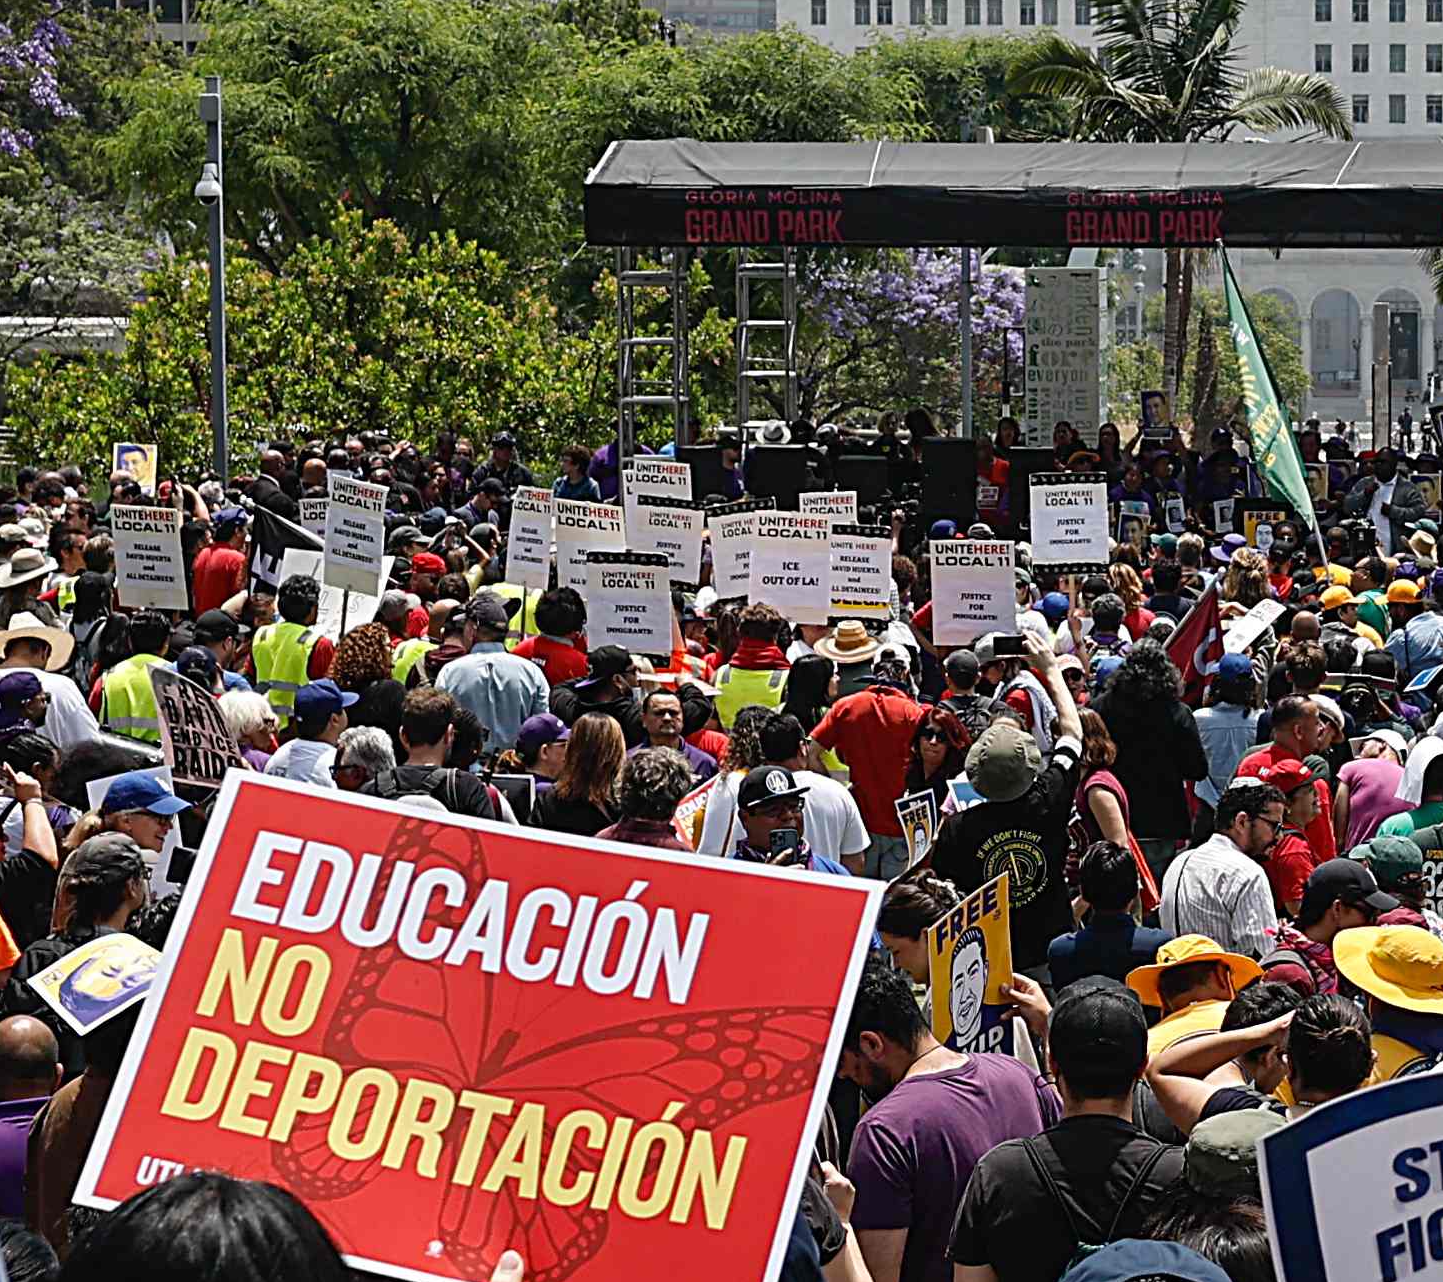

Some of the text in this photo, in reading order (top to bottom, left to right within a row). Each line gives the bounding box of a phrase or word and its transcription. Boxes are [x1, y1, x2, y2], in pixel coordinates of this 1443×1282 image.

[685, 190, 842, 204] GLORIA MOLINA
[1068, 191, 1224, 206] GLORIA MOLINA
[684, 209, 844, 243] GRAND PARK
[1067, 210, 1224, 243] GRAND PARK
[636, 474, 686, 485] LOCAL 11
[332, 493, 382, 512] LOCAL 11
[514, 502, 540, 512] LOCAL
[1045, 497, 1093, 506] LOCAL 11
[557, 503, 620, 520] UNITEHERE!
[803, 506, 853, 514] LOCAL 11
[114, 520, 175, 534] LOCAL 11
[557, 515, 621, 532] LOCAL 11
[649, 518, 691, 530] LOCAL 11
[759, 516, 828, 528] UNITEHERE!
[1057, 518, 1085, 526] JUSTICE
[722, 527, 752, 538] LOCAL
[758, 528, 827, 540] LOCAL 11
[935, 544, 1009, 555] UNITEHERE!
[782, 562, 800, 571] ICE
[936, 556, 1010, 567] LOCAL 11
[630, 572, 654, 580] HERE!
[762, 576, 819, 586] OUT OF LA!
[602, 579, 655, 589] LOCAL 11
[960, 593, 991, 601] JUSTICE
[614, 605, 647, 613] JUSTICE
[969, 603, 984, 611] FOR
[623, 616, 640, 624] FOR
[172, 726, 237, 755] END ICE
[1019, 829, 1042, 844] FIGHT
[230, 828, 711, 1006] EDUCACIÓN
[934, 883, 998, 958] FREE
[194, 927, 333, 1039] NO
[159, 1029, 750, 1232] DEPORTACIÓN
